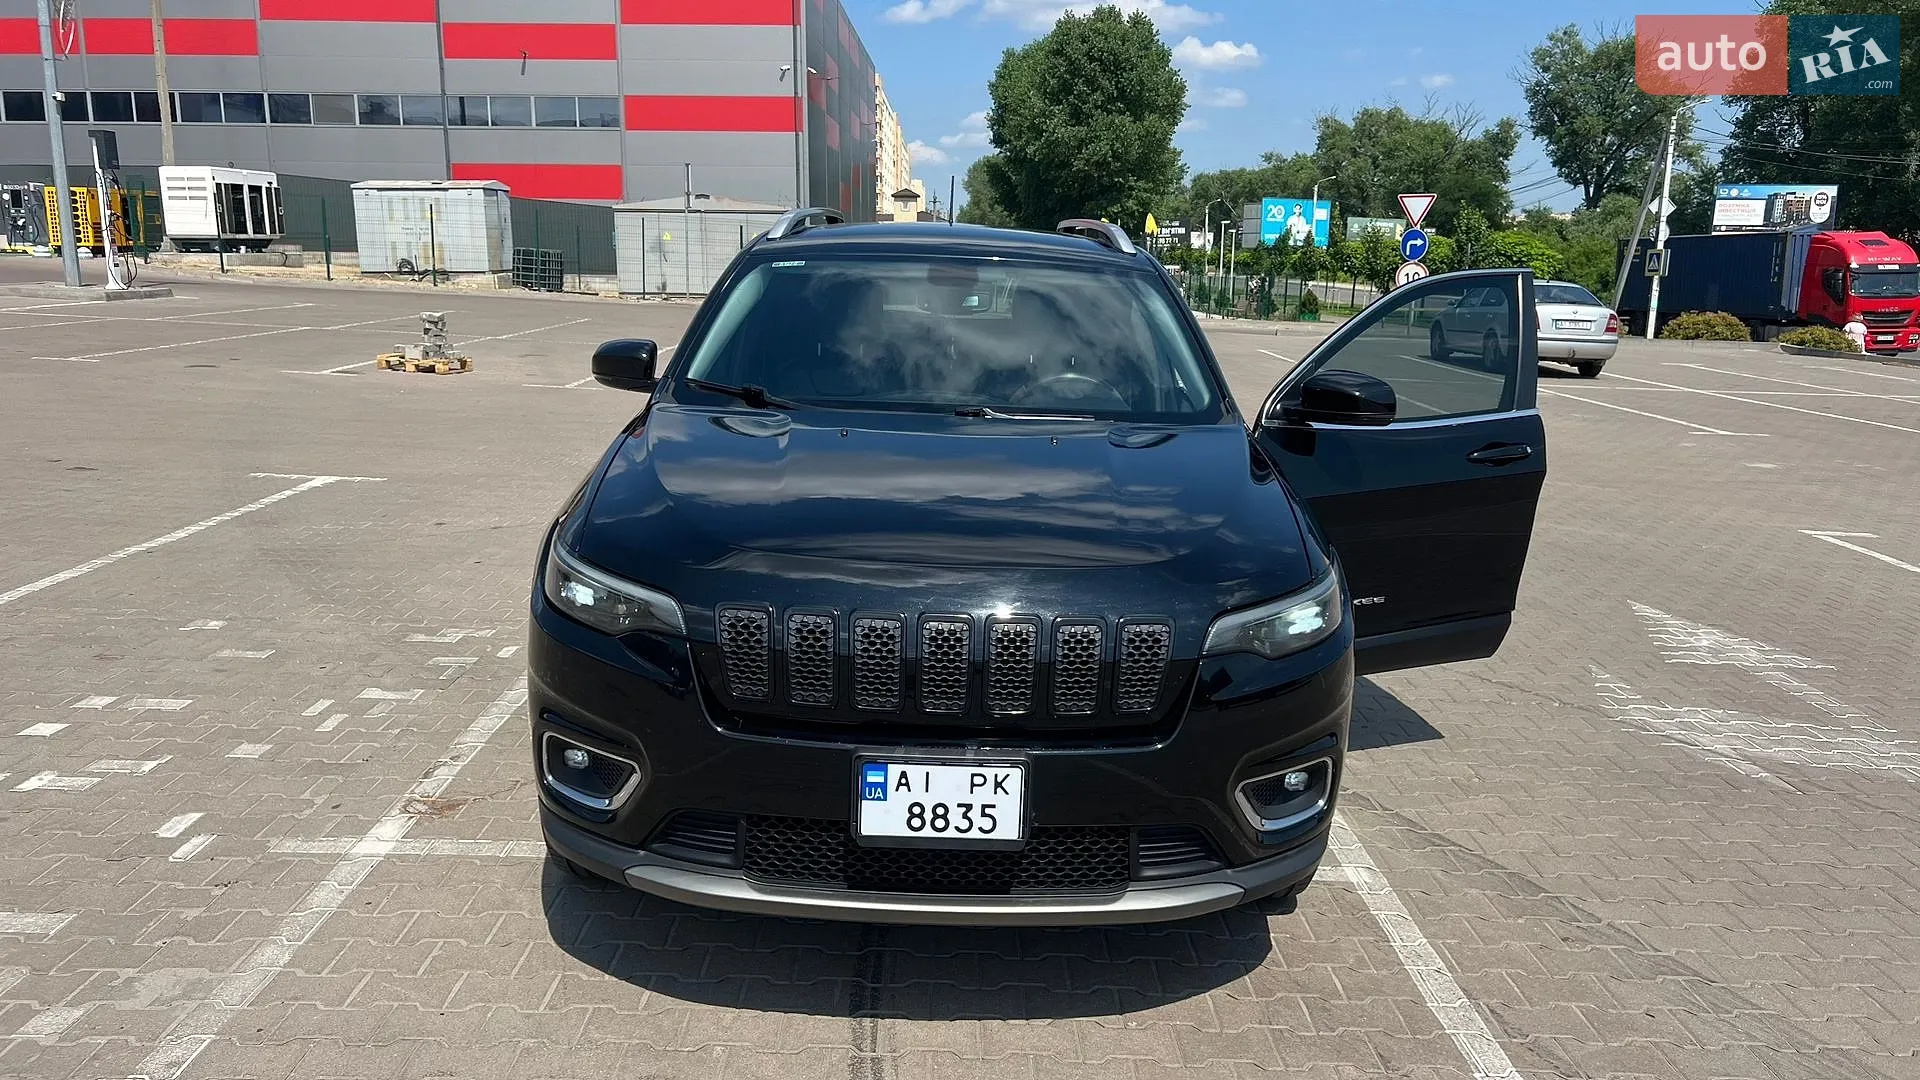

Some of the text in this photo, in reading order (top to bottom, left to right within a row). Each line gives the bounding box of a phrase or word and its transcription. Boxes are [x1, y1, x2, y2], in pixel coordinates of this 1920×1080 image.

[1266, 204, 1285, 219] 20
[895, 770, 1010, 795] AI PK
[865, 787, 884, 799] UA
[906, 801, 997, 834] 8835
